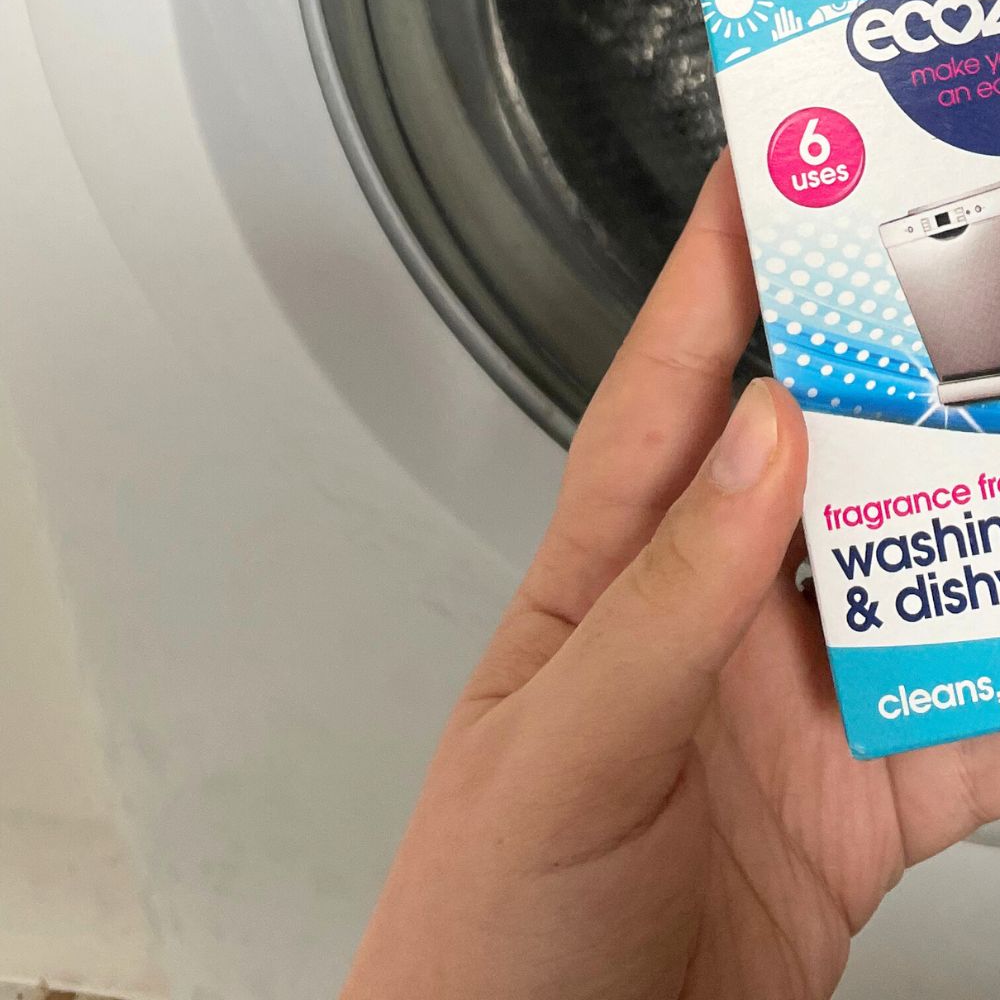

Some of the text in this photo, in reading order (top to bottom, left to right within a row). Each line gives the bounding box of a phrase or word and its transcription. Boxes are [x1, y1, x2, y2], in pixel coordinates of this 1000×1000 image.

[911, 58, 980, 87] make
[938, 83, 970, 108] an
[799, 118, 831, 166] 6
[791, 164, 849, 191] uses
[823, 484, 970, 530] fragrance
[846, 586, 883, 631] &
